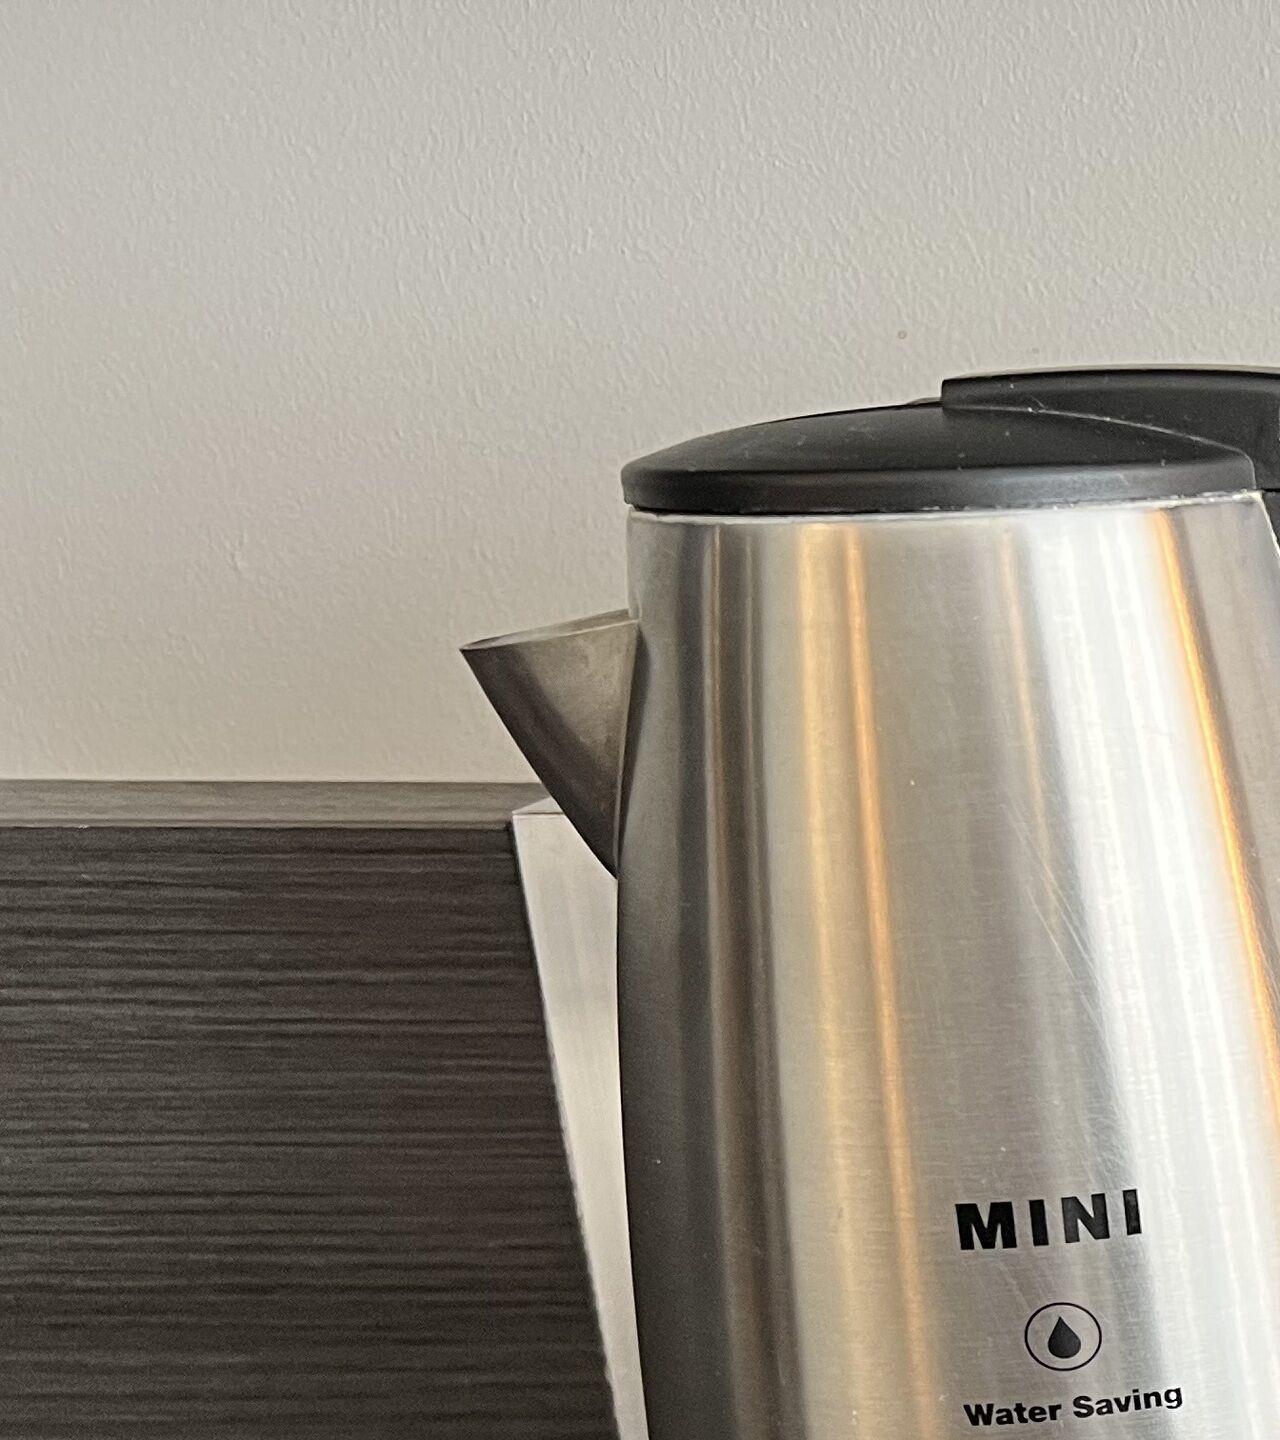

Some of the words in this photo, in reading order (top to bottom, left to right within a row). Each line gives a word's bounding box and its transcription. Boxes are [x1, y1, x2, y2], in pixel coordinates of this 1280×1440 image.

[955, 1188, 1142, 1250] MINI
[963, 1401, 1062, 1427] Water
[1072, 1387, 1184, 1419] Saving
